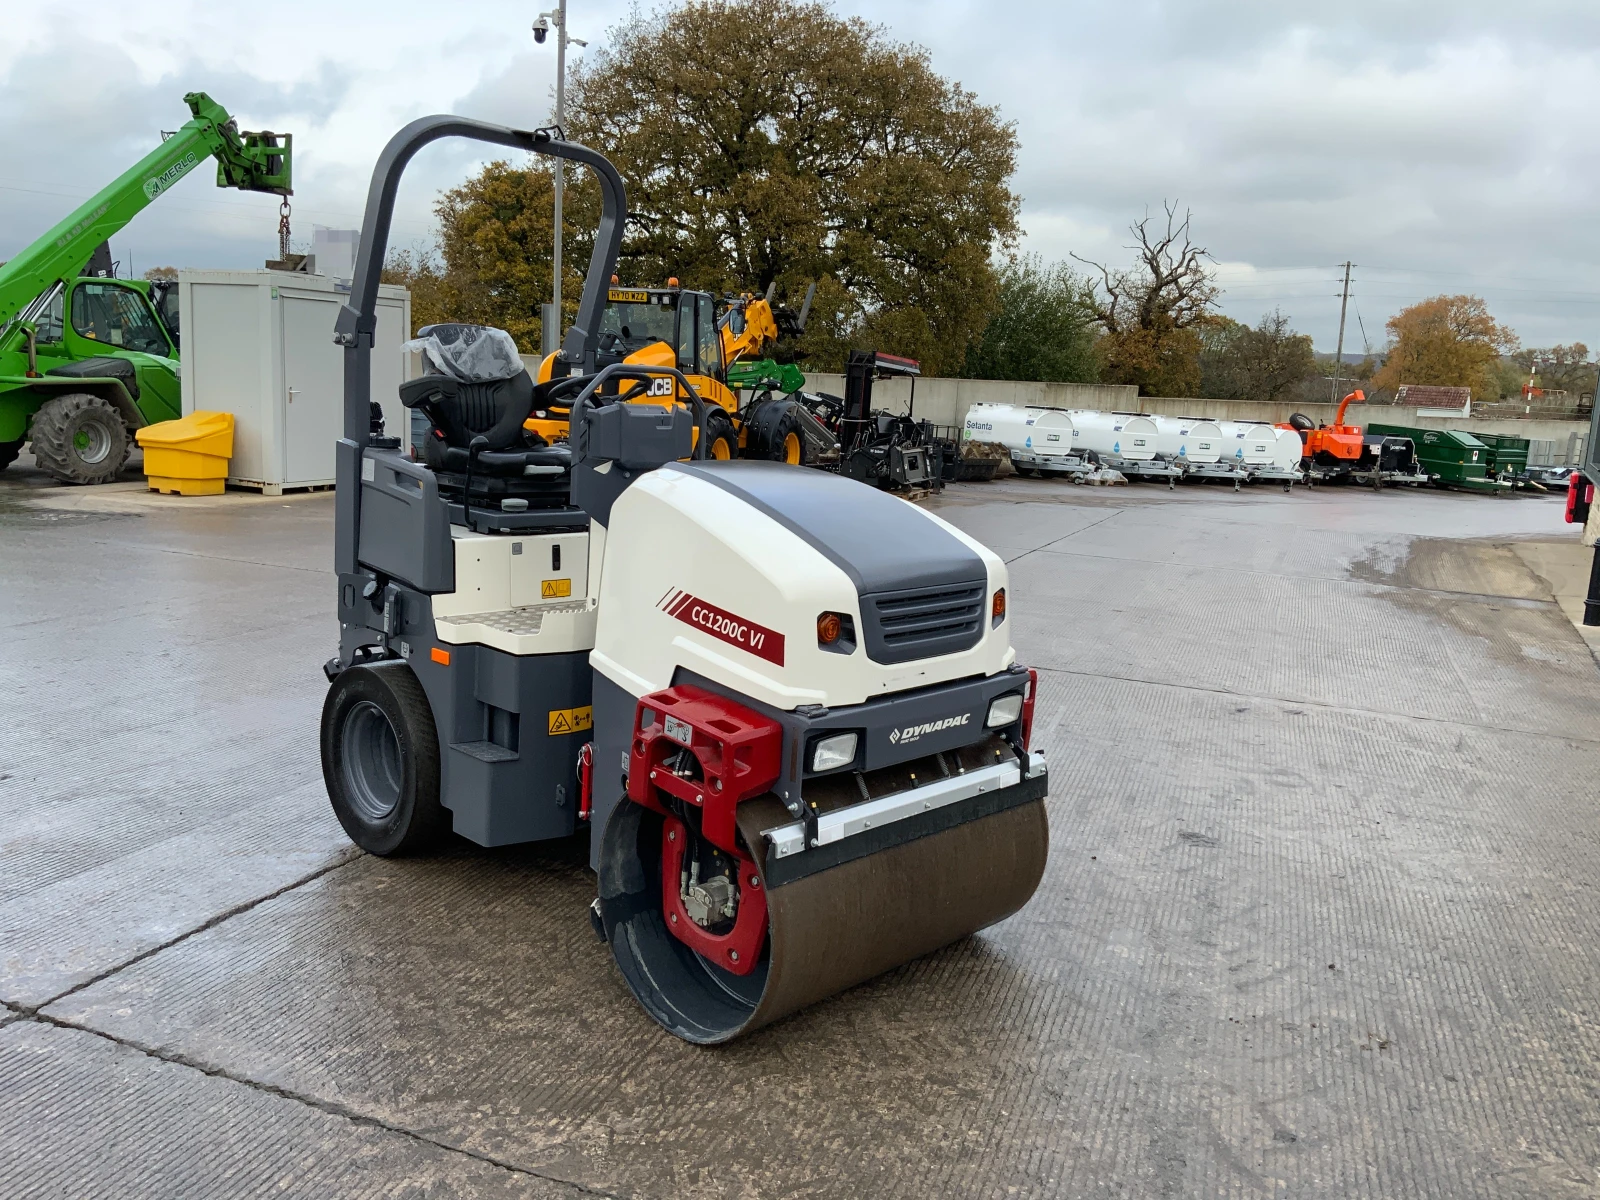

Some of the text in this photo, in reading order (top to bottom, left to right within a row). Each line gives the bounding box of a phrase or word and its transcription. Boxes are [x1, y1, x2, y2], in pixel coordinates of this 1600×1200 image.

[159, 152, 196, 185] MERLO
[611, 291, 645, 301] HY70 WZZ
[646, 378, 672, 396] JCB
[966, 420, 993, 431] Setanta
[691, 605, 765, 650] CC1200C VI
[901, 713, 971, 740] DYNAPAC
